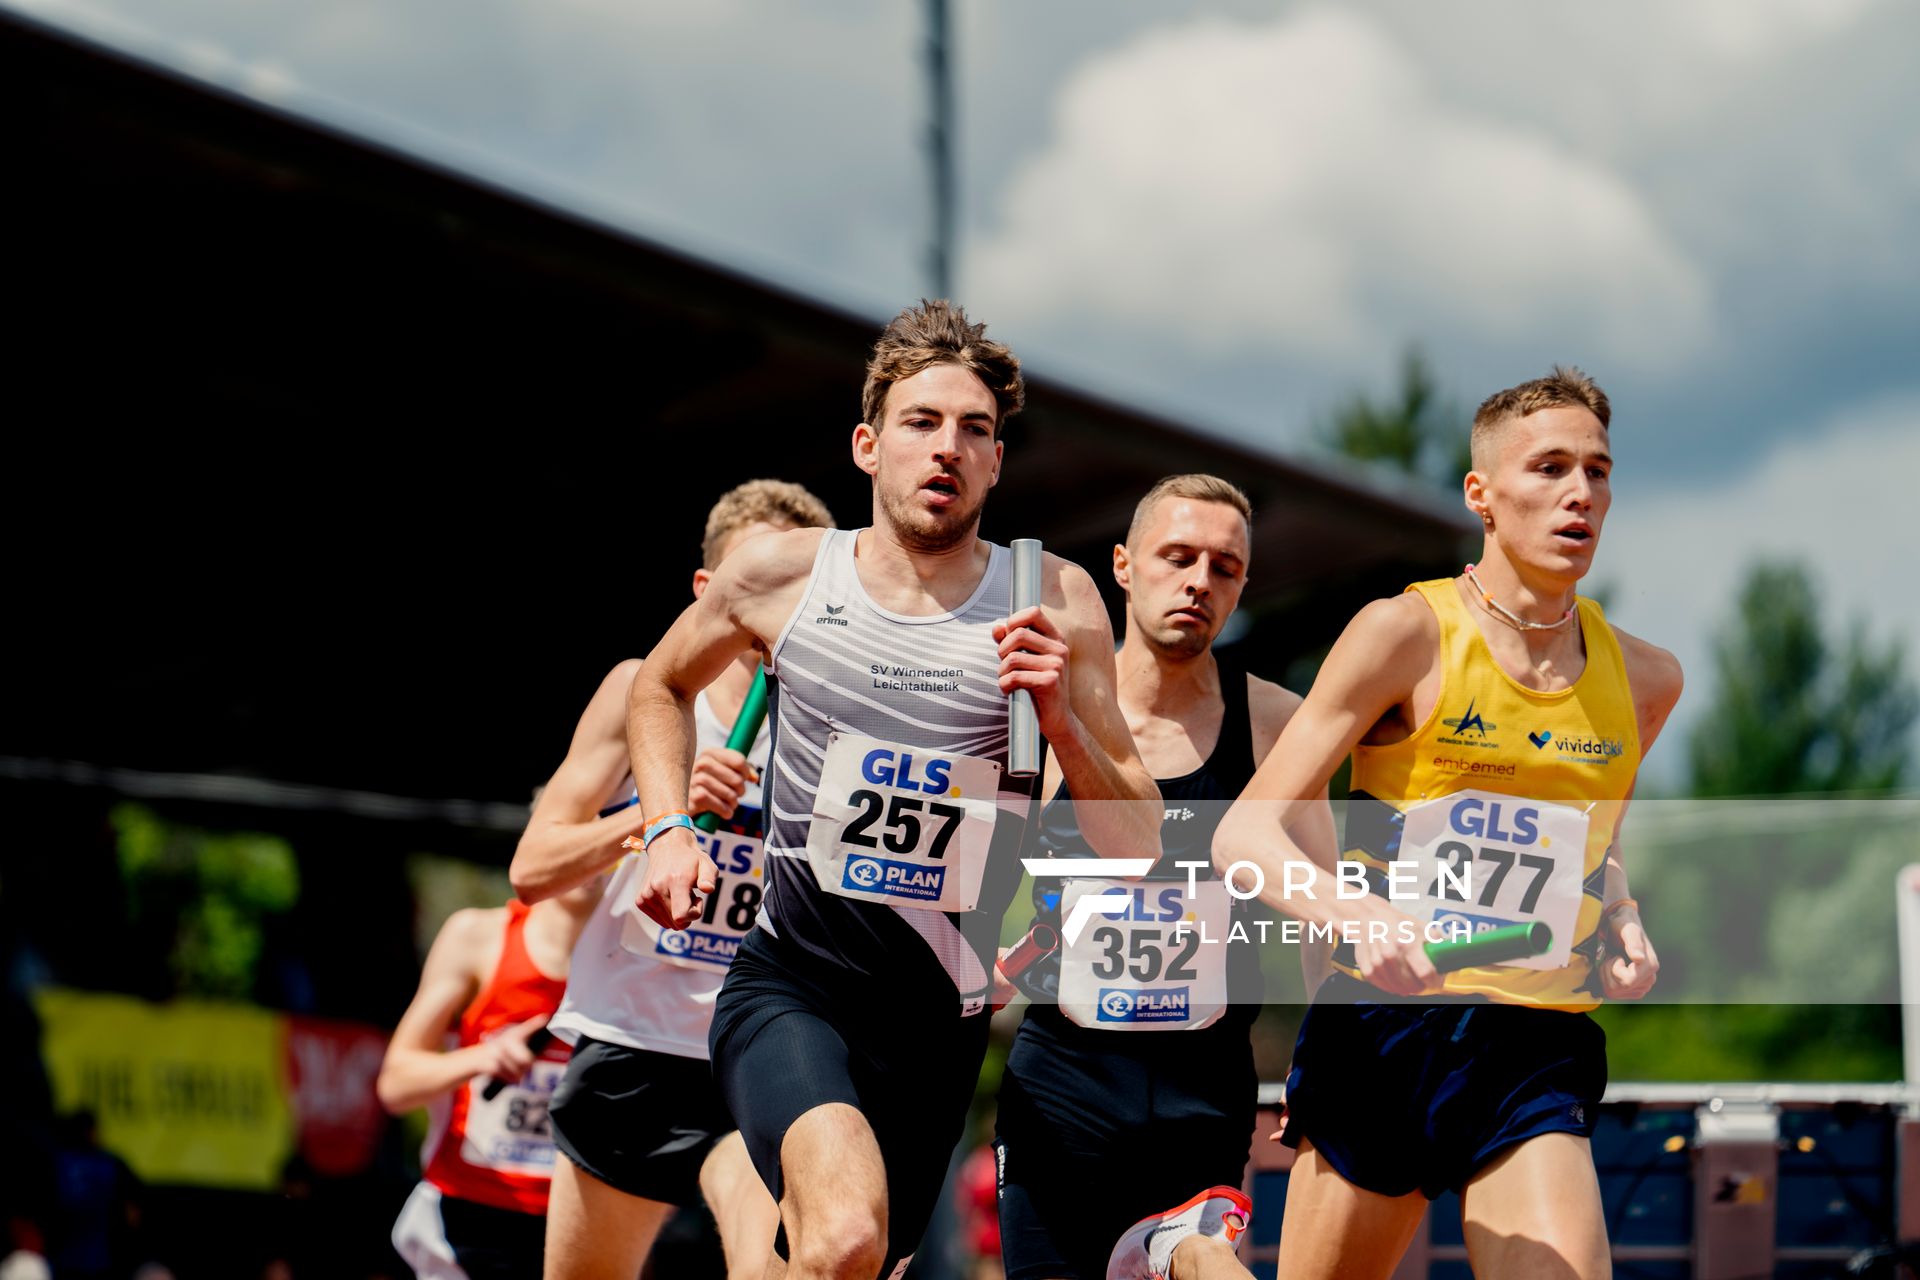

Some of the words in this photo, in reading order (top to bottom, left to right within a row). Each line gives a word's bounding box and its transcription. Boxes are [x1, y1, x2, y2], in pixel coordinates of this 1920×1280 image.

[816, 615, 848, 627] erima
[870, 664, 889, 675] SV
[892, 667, 964, 678] Winnenden
[873, 678, 960, 693] Leichtathletik
[1433, 757, 1515, 776] embemed
[840, 789, 966, 860] 257
[696, 836, 762, 878] LS.
[886, 866, 940, 889] PLAN
[1428, 840, 1555, 914] 277
[884, 884, 937, 897] INTERNATIONAL
[692, 877, 762, 931] 18
[1091, 926, 1200, 982] 352
[1136, 994, 1186, 1010] PLAN
